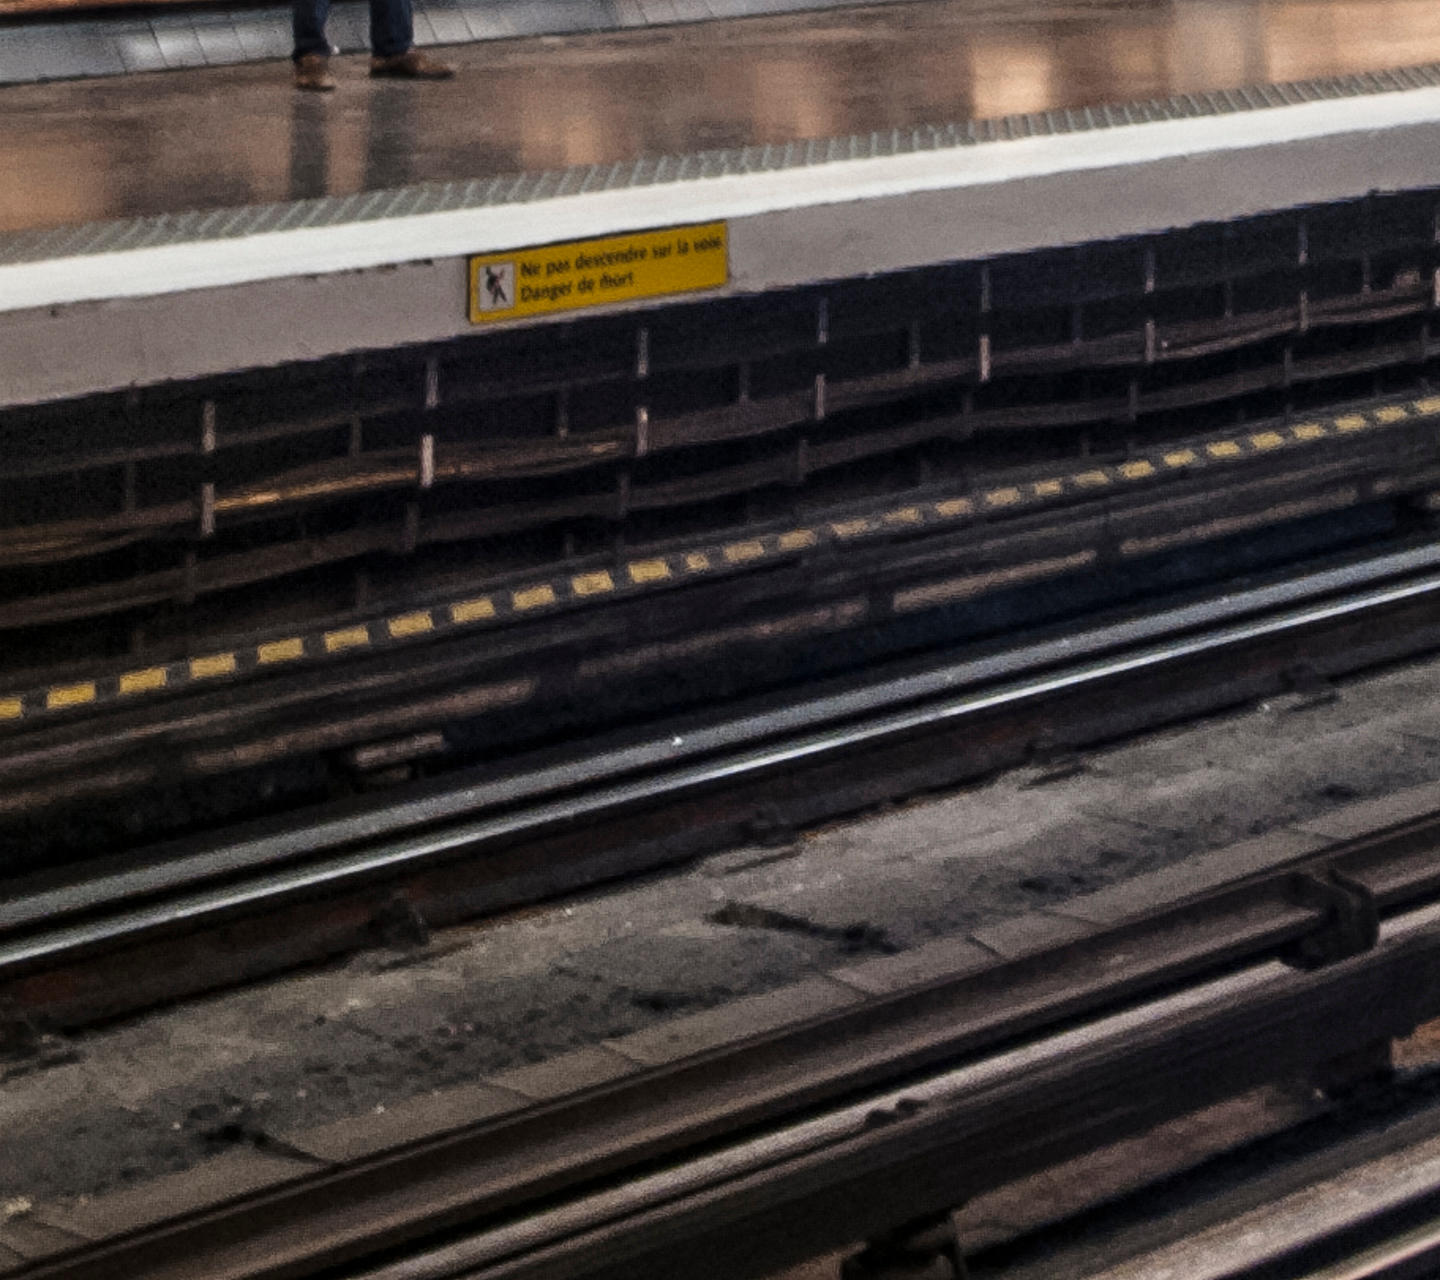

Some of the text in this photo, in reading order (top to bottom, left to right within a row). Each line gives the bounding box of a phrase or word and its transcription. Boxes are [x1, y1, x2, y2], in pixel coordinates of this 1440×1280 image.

[520, 235, 722, 277] Ne pas descendre sur la voie
[520, 272, 634, 301] Danger de mort
